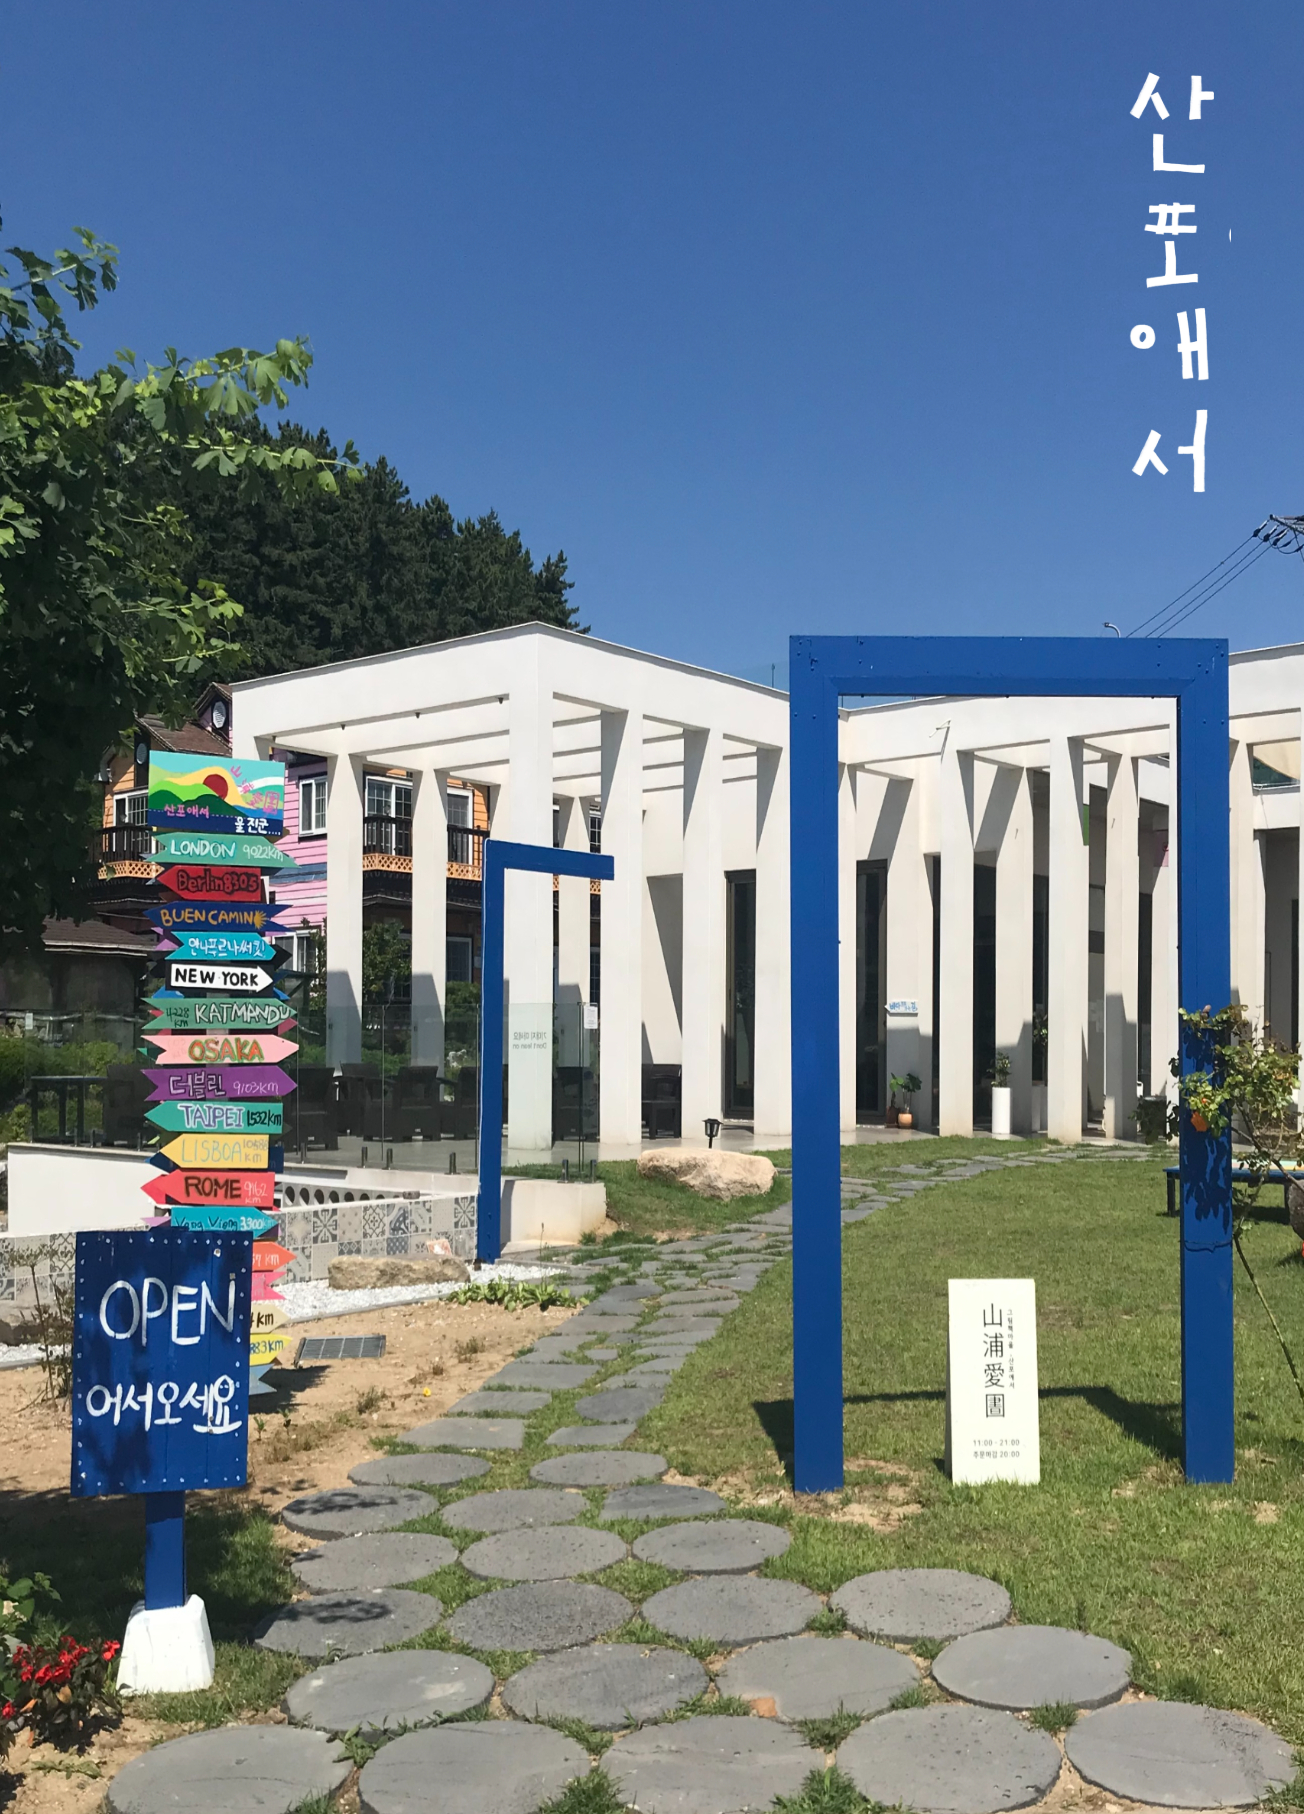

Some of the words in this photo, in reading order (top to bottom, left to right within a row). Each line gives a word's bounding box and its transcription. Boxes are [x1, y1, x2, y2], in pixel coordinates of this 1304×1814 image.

[170, 838, 236, 859] LONDON
[160, 908, 206, 927] BUEN
[175, 968, 215, 984] NEW
[222, 971, 259, 987] YORK
[194, 1001, 290, 1025] KATMANDU
[188, 1037, 265, 1063] OSAKA
[169, 1071, 226, 1099] 더블린
[177, 1103, 245, 1129] TAIPEI
[181, 1138, 242, 1163] LISBOA
[184, 1176, 241, 1199] ROME
[100, 1277, 235, 1347] OPEN
[86, 1374, 242, 1435] 어서오세요
[973, 1439, 993, 1447] 11:00
[999, 1438, 1020, 1447] 21:00
[999, 1450, 1020, 1458] 20:00
